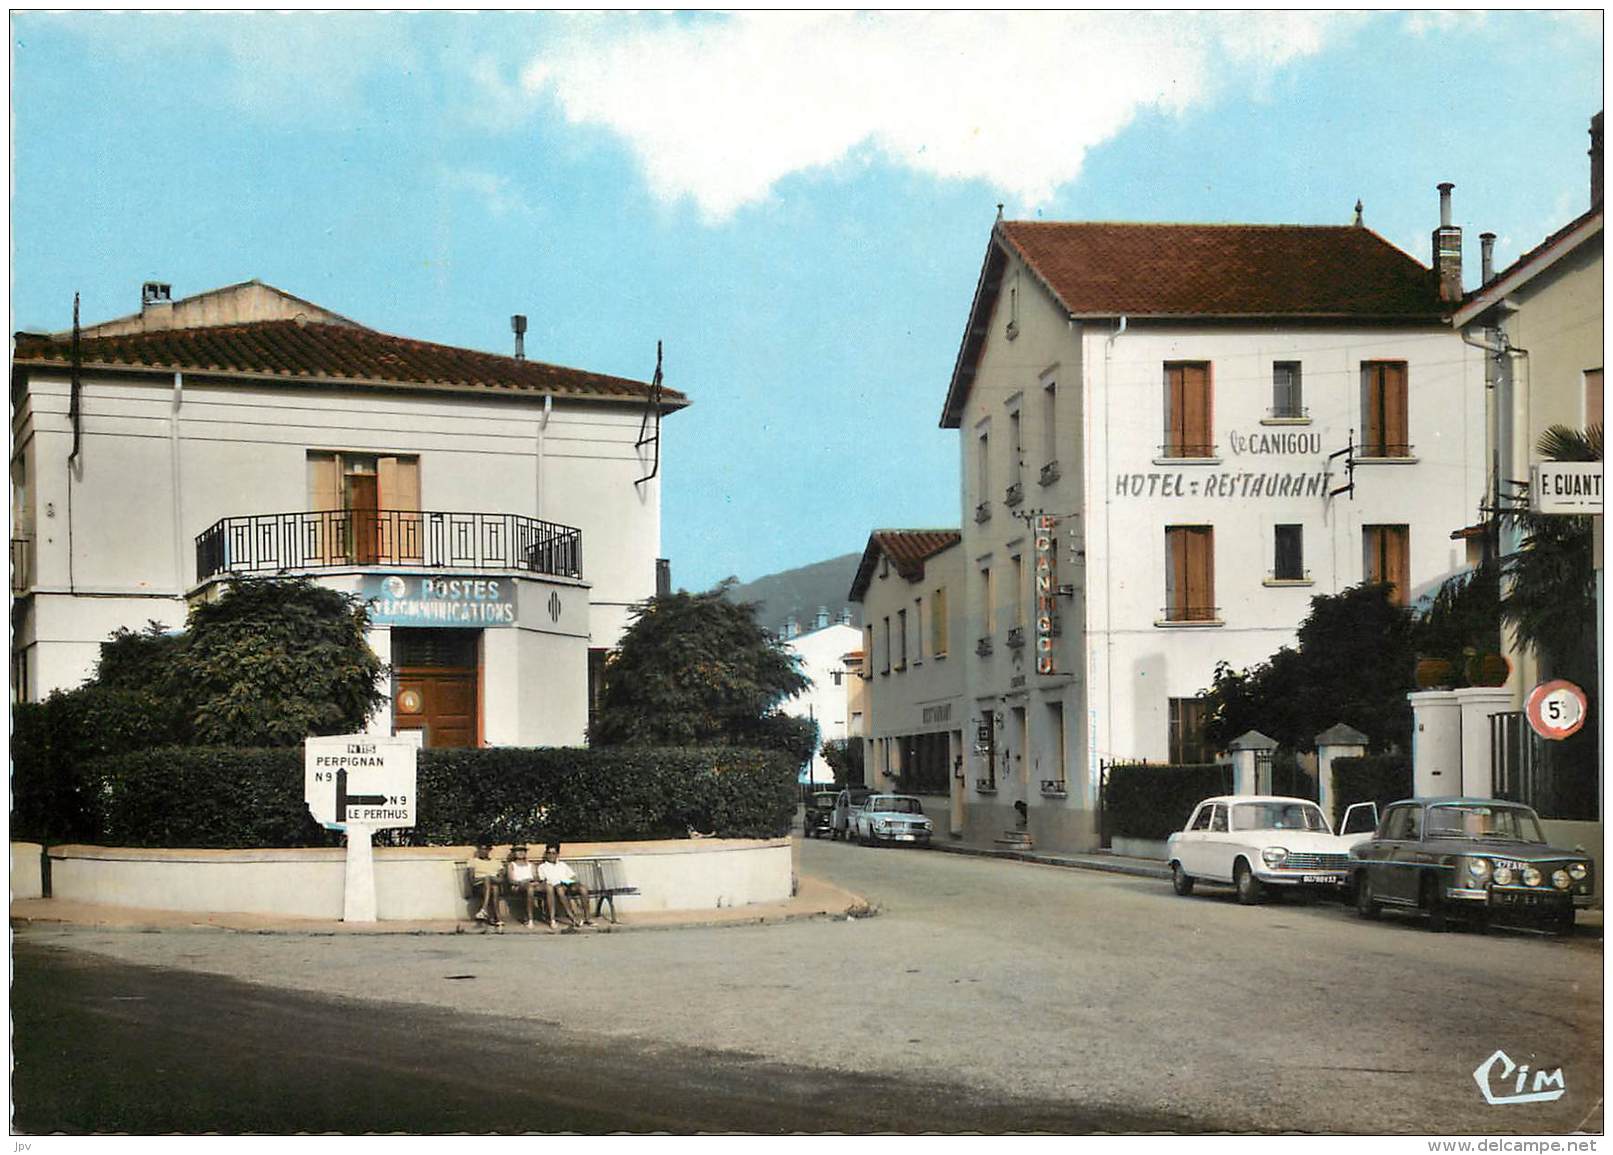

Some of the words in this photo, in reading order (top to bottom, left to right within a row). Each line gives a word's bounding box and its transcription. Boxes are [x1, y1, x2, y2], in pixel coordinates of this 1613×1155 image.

[1249, 433, 1321, 455] CANIGOU
[1115, 473, 1185, 497] HOTEL
[1204, 472, 1334, 498] RESTAURANT
[1555, 474, 1602, 495] GUANT
[422, 578, 499, 600] POSTES
[316, 757, 384, 767] PERPIGNAN
[315, 772, 323, 782] N
[325, 772, 332, 782] 9
[390, 796, 397, 805] N
[400, 796, 407, 805] 9
[348, 809, 360, 819] LE
[364, 809, 408, 819] PERTHUS
